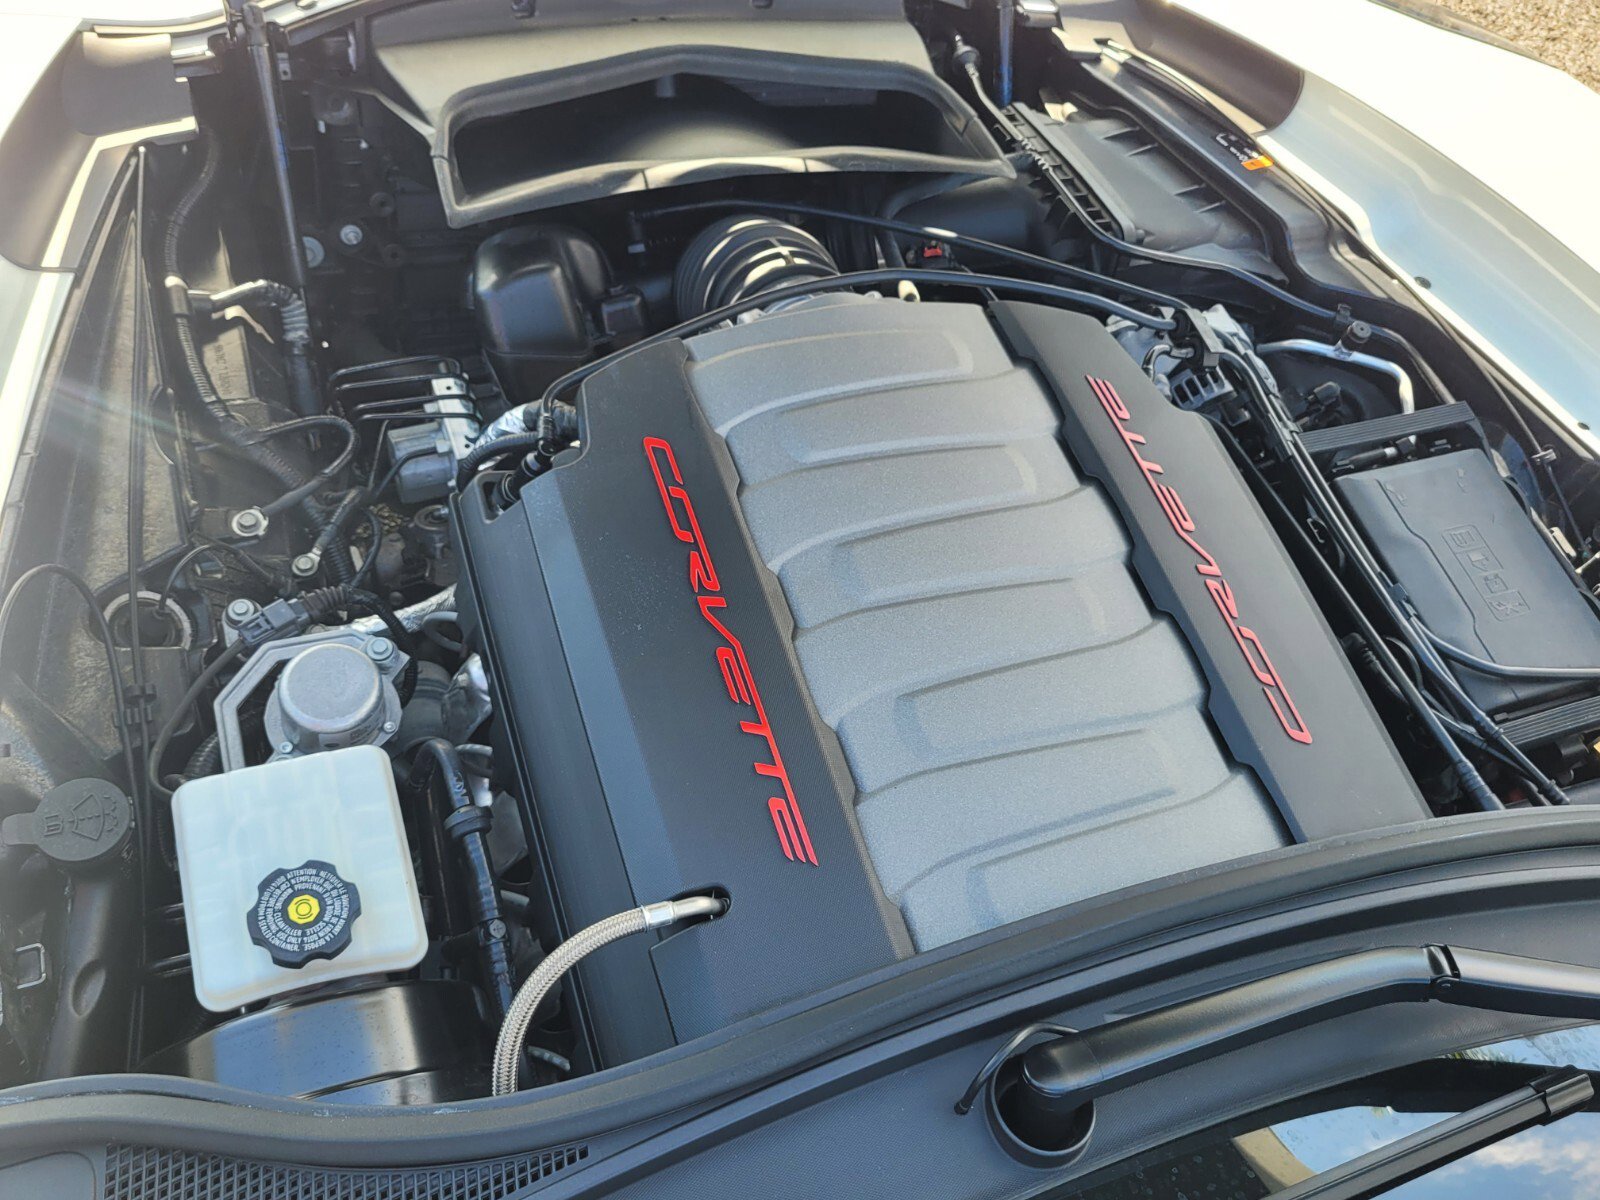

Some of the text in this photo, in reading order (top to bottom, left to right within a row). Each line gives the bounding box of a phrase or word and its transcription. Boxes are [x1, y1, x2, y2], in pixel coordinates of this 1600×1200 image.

[643, 437, 818, 866] CORVETTE
[1085, 374, 1312, 744] CORVETTE
[325, 932, 334, 942] LA
